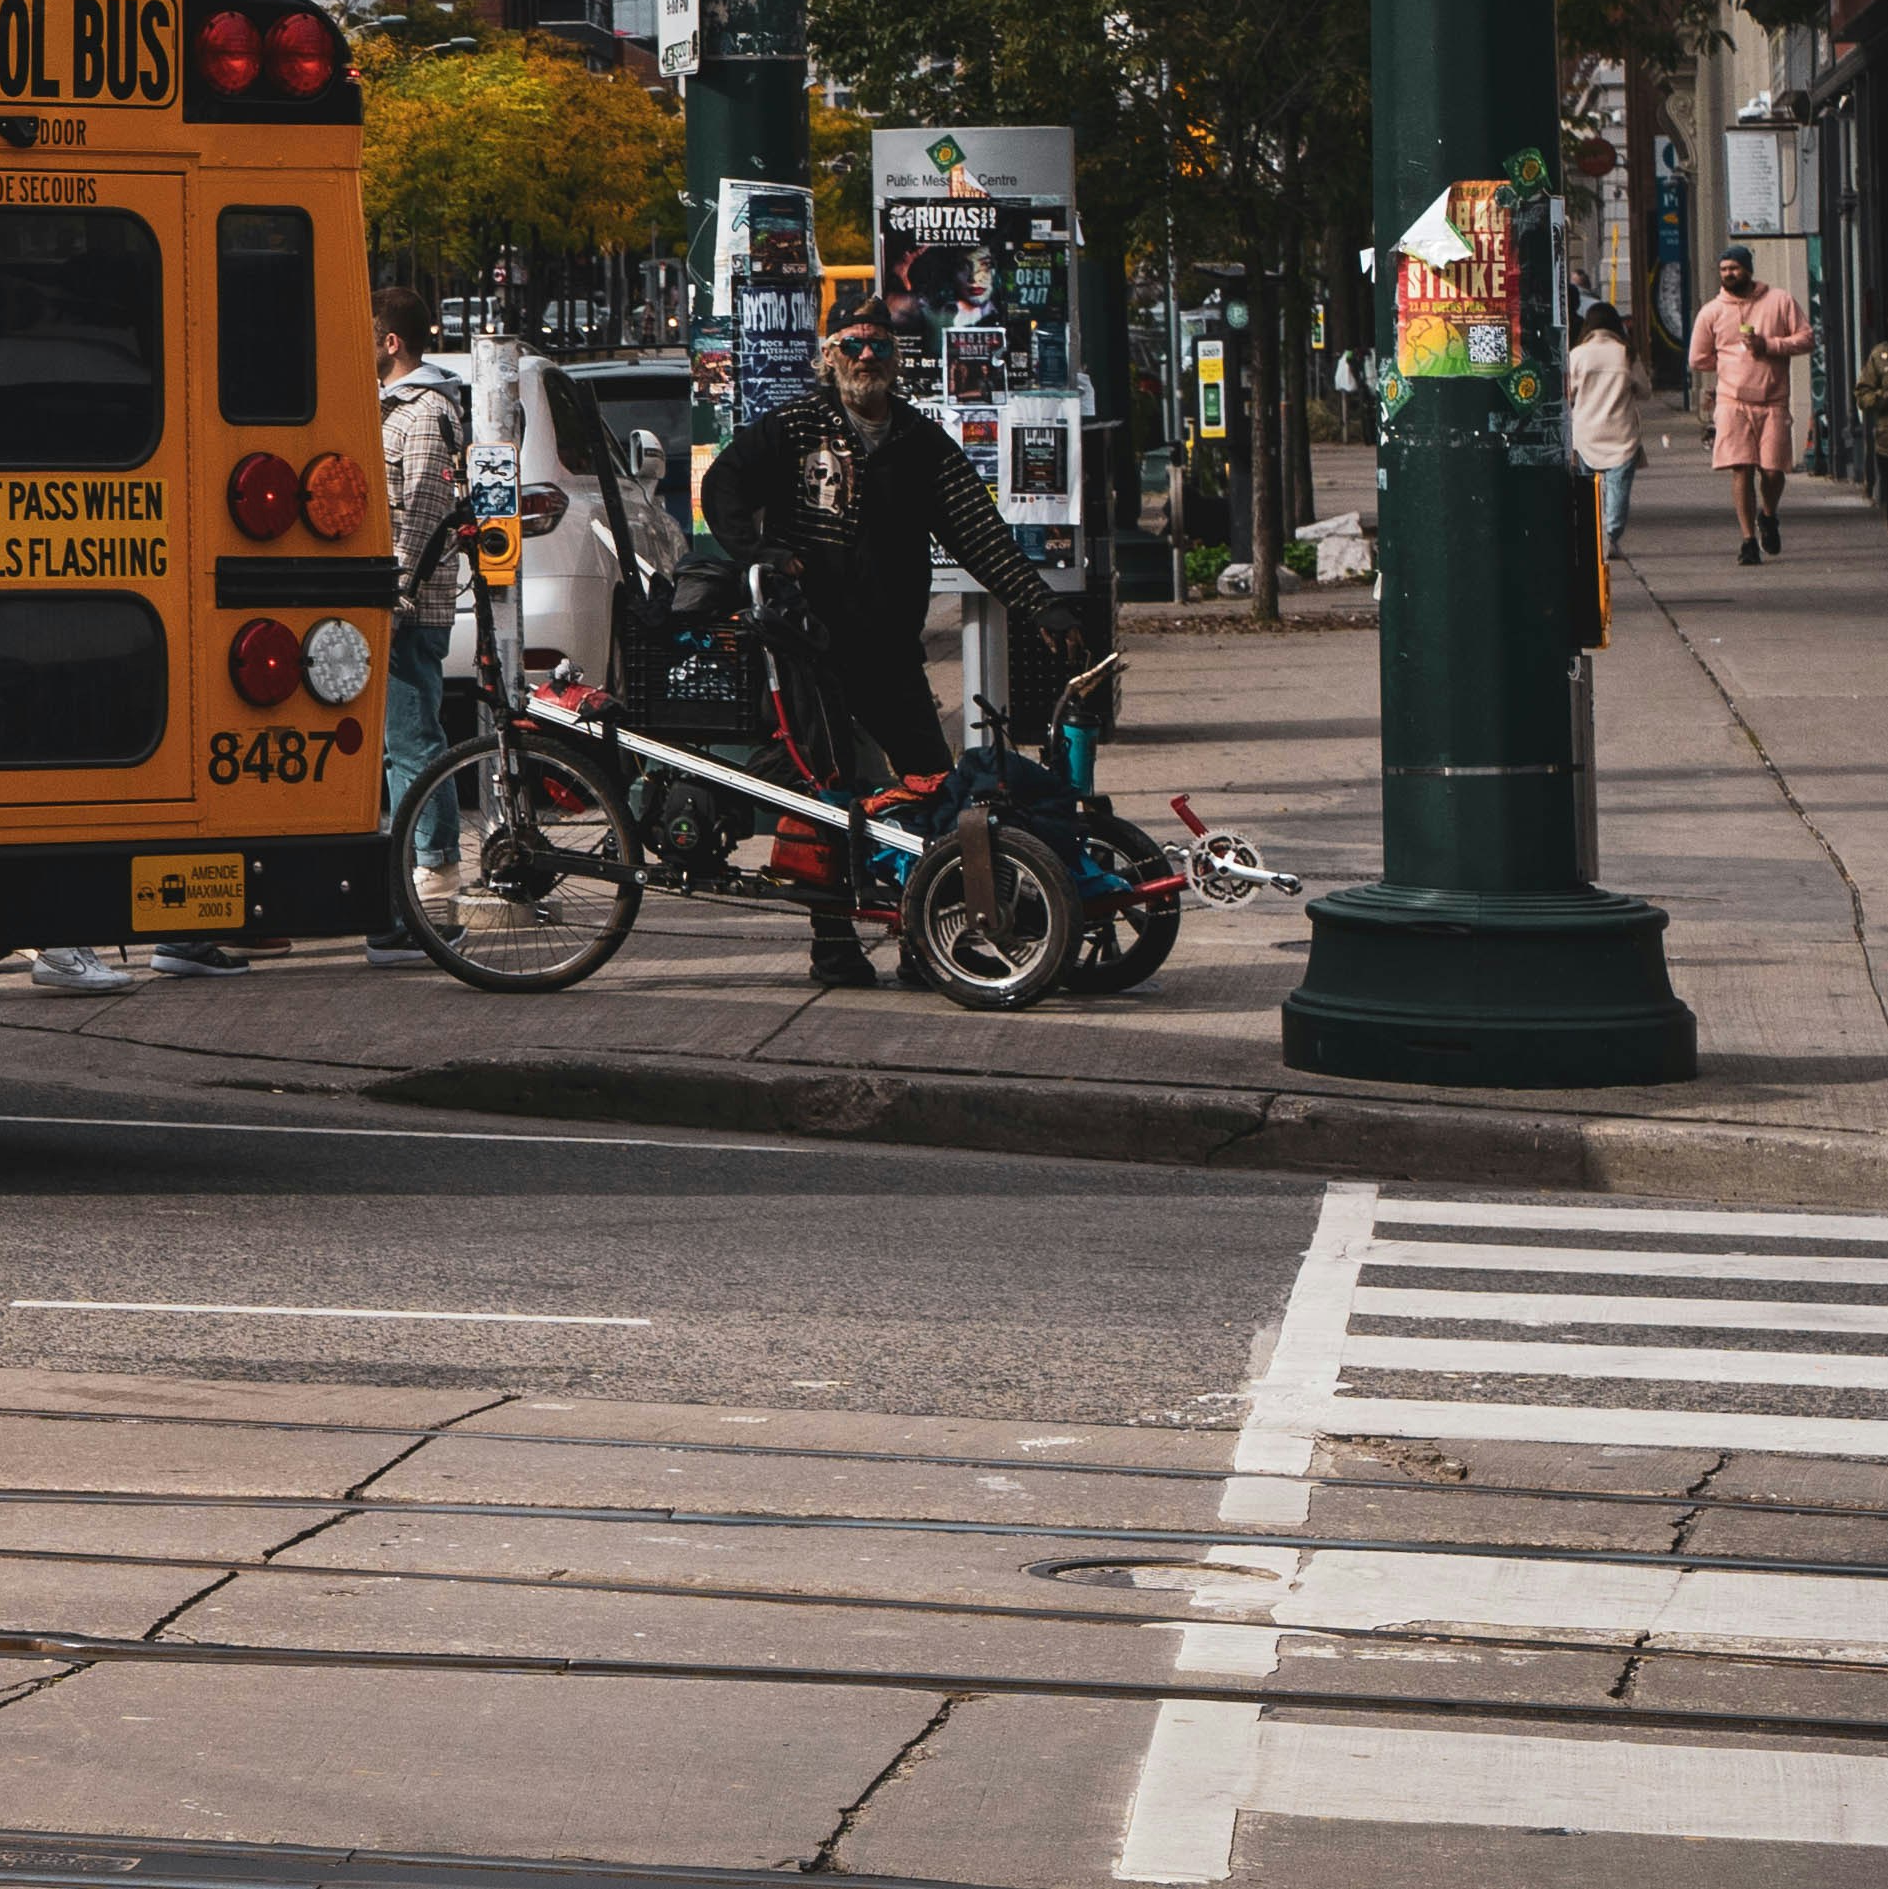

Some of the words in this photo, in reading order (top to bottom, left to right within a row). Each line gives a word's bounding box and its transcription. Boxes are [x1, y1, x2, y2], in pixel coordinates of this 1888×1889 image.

[38, 119, 87, 146] DOOR
[18, 176, 97, 204] SECOURS
[886, 174, 919, 187] Public
[977, 173, 1017, 186] Centre
[916, 206, 980, 229] RUTAS
[915, 229, 981, 241] FESTIVAL
[1016, 268, 1051, 285] OPEN
[1407, 262, 1507, 299] STRIKE
[743, 292, 787, 332] BYSTRO
[8, 481, 79, 521] PASS
[84, 480, 163, 521] WHEN
[29, 537, 168, 578] FLASHING
[208, 730, 338, 785] 8487
[191, 865, 238, 880] AMENDE
[187, 883, 243, 899] MAXIMALE
[198, 903, 223, 917] 2000
[225, 902, 232, 918] $
